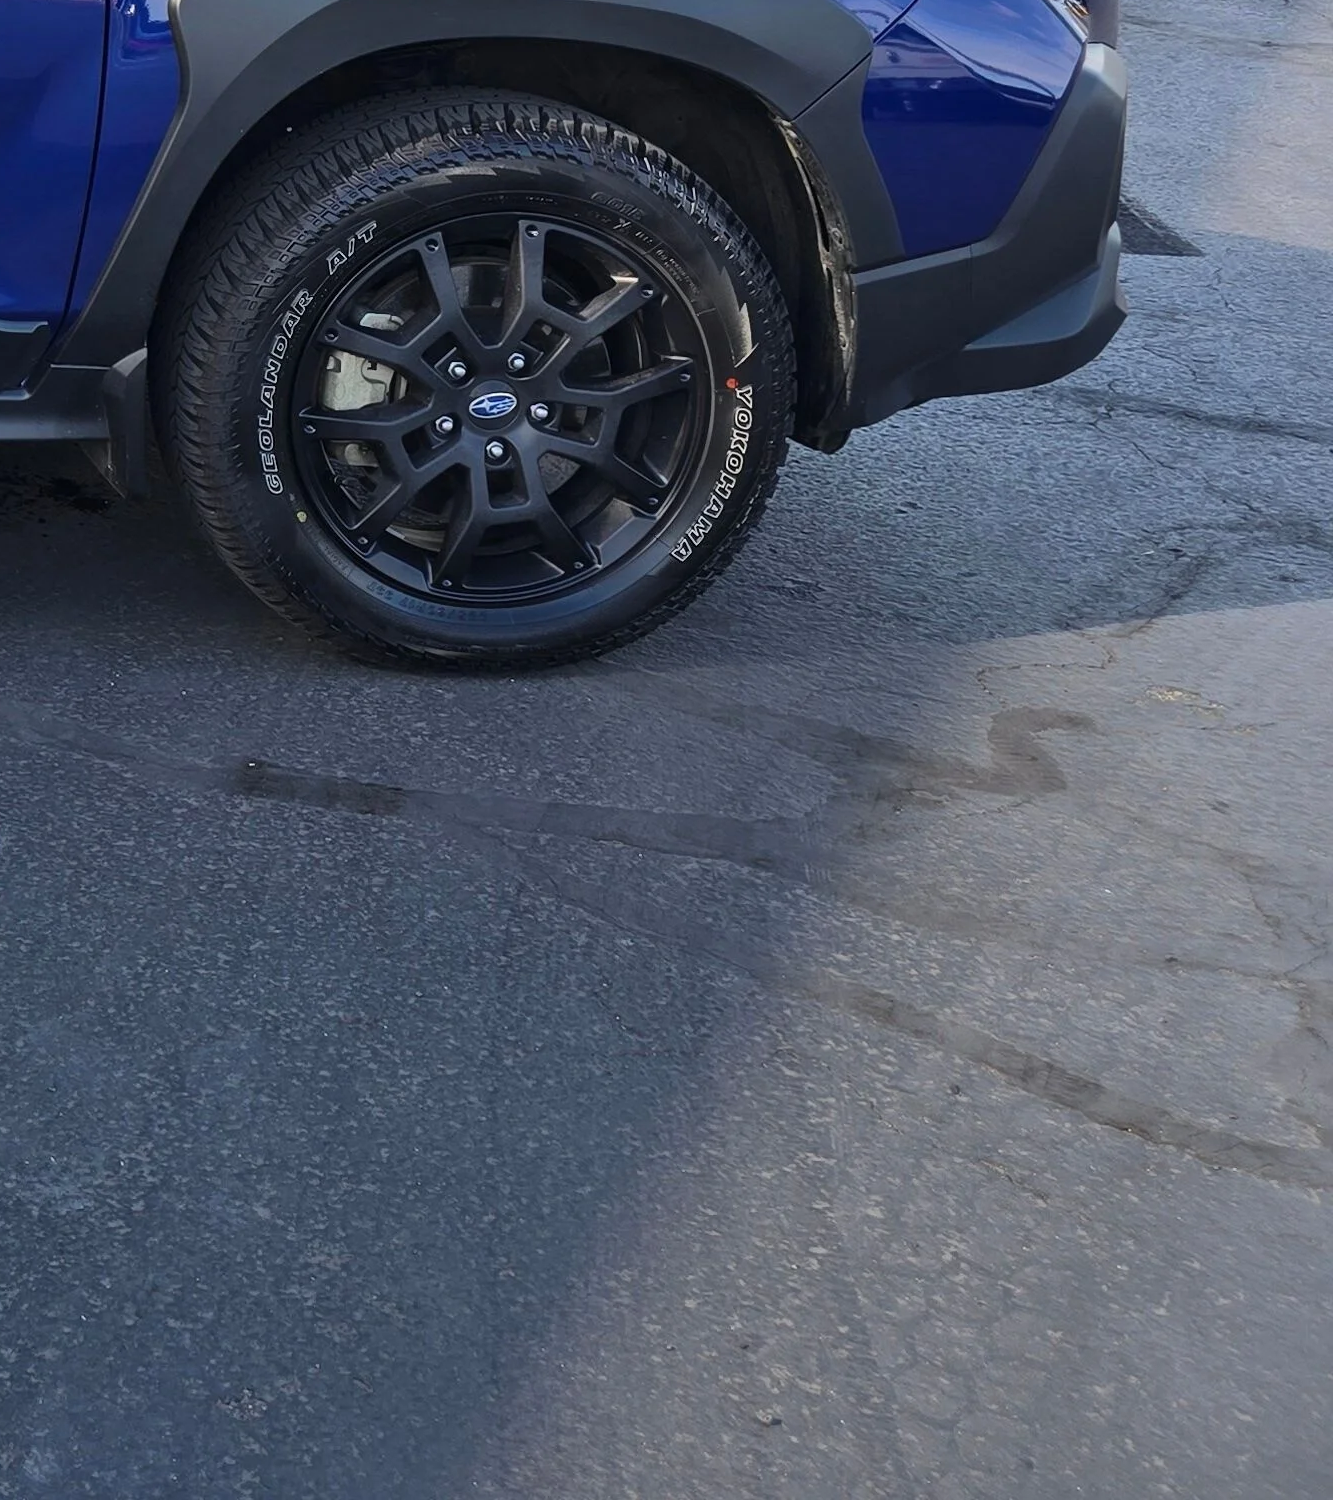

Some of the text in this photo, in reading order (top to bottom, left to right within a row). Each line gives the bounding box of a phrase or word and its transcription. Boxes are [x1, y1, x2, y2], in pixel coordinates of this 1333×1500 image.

[258, 220, 377, 495] GEOLANDAR A/T
[671, 384, 753, 562] YOKOHAMA
